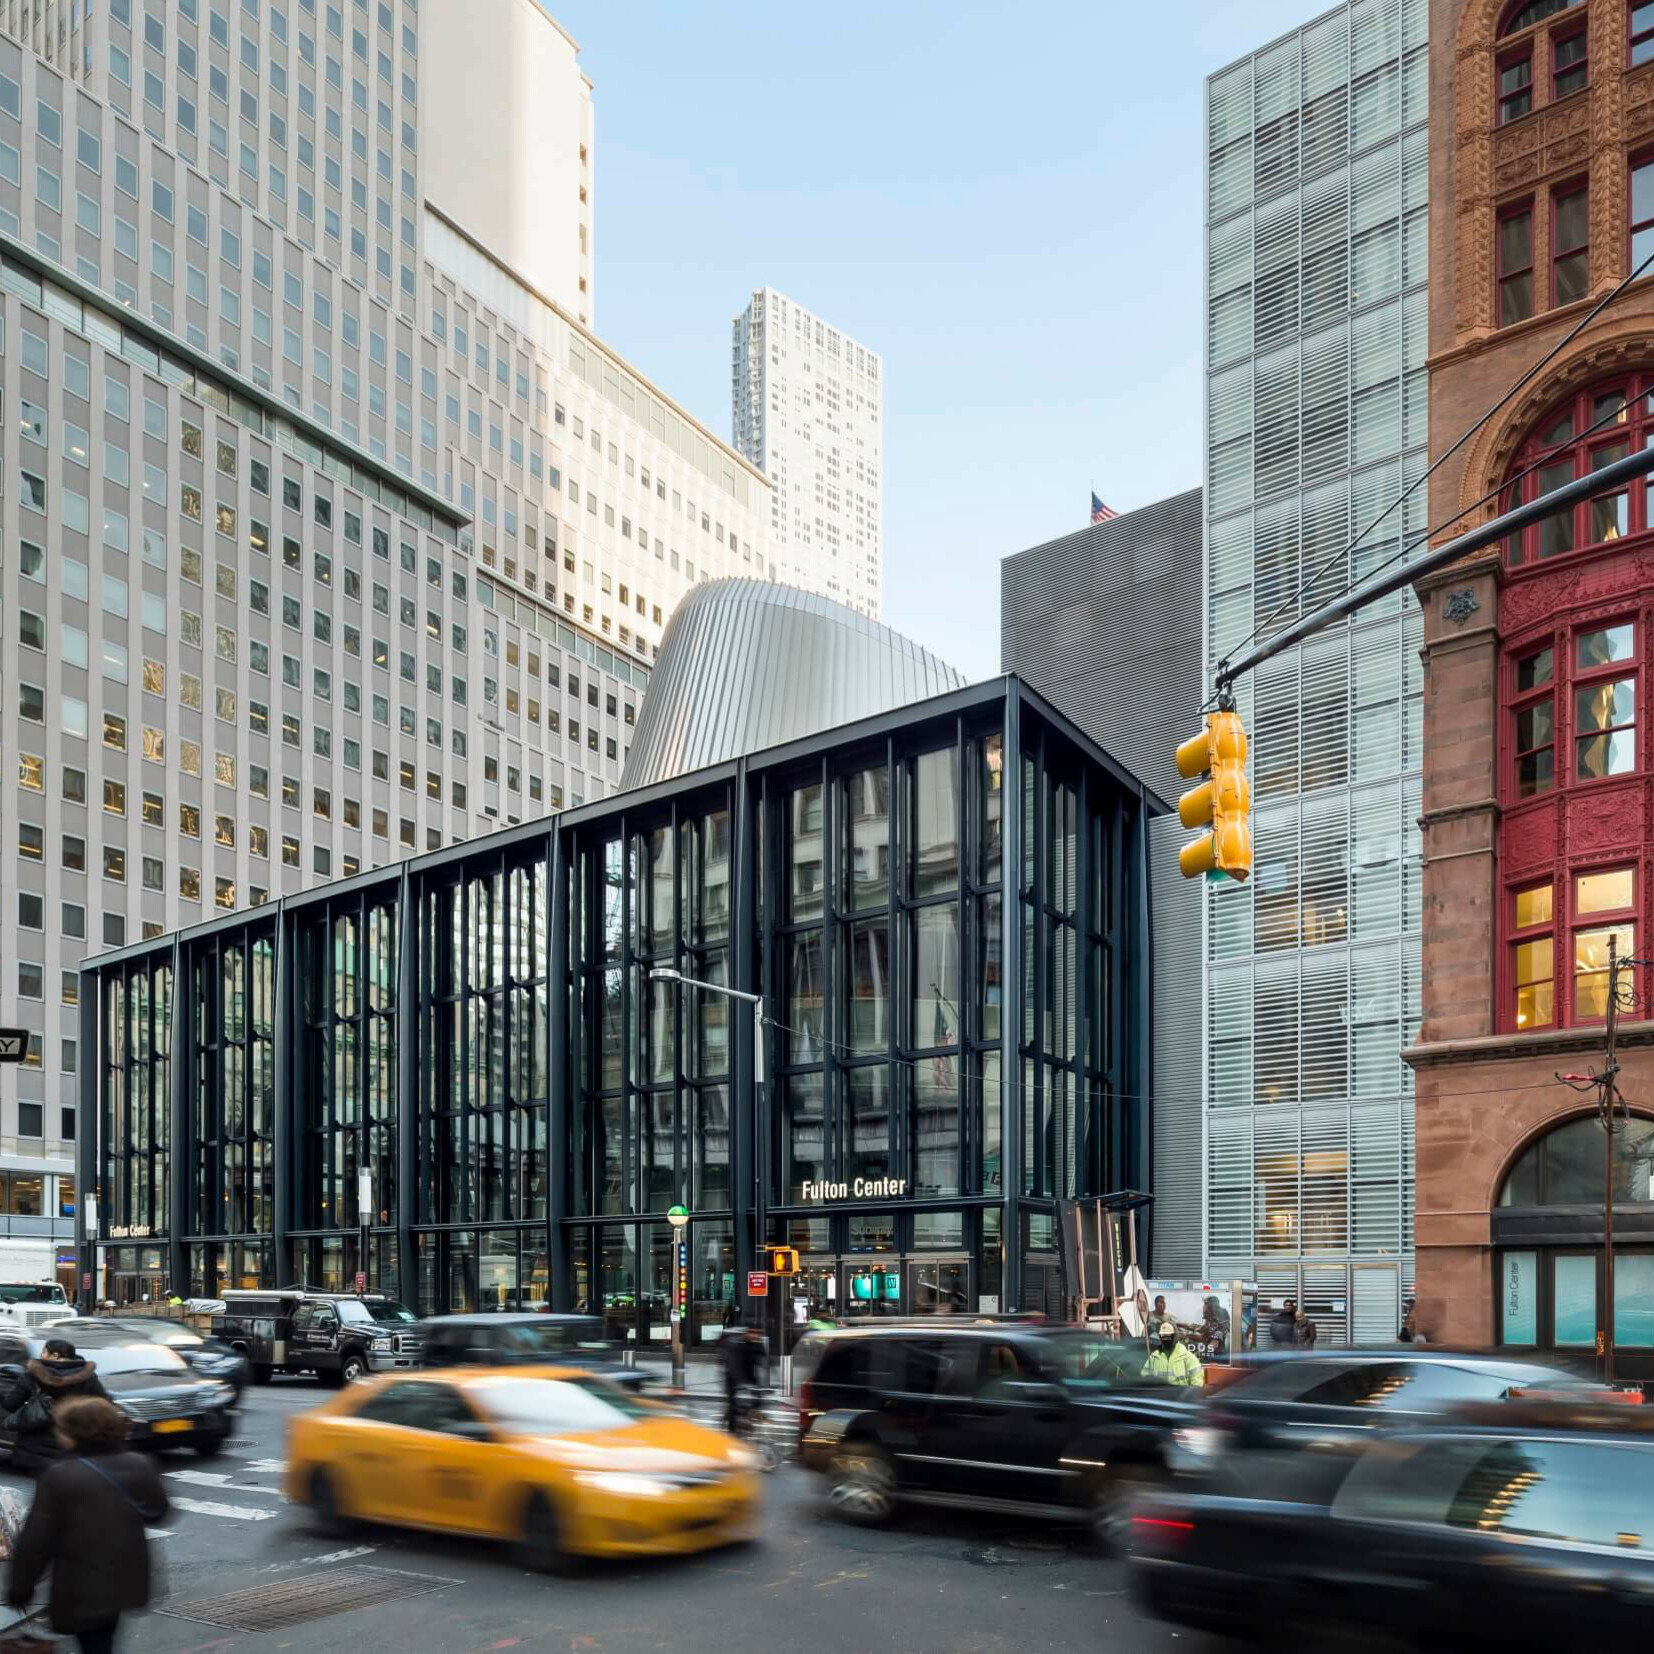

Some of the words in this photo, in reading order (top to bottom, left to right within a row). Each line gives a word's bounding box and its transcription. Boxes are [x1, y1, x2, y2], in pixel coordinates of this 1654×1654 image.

[0, 1039, 15, 1053] Y
[802, 1180, 847, 1200] Fulton
[854, 1177, 906, 1197] Center
[130, 1224, 150, 1237] Center
[1509, 1262, 1520, 1290] Center
[1509, 1290, 1519, 1316] Fulton
